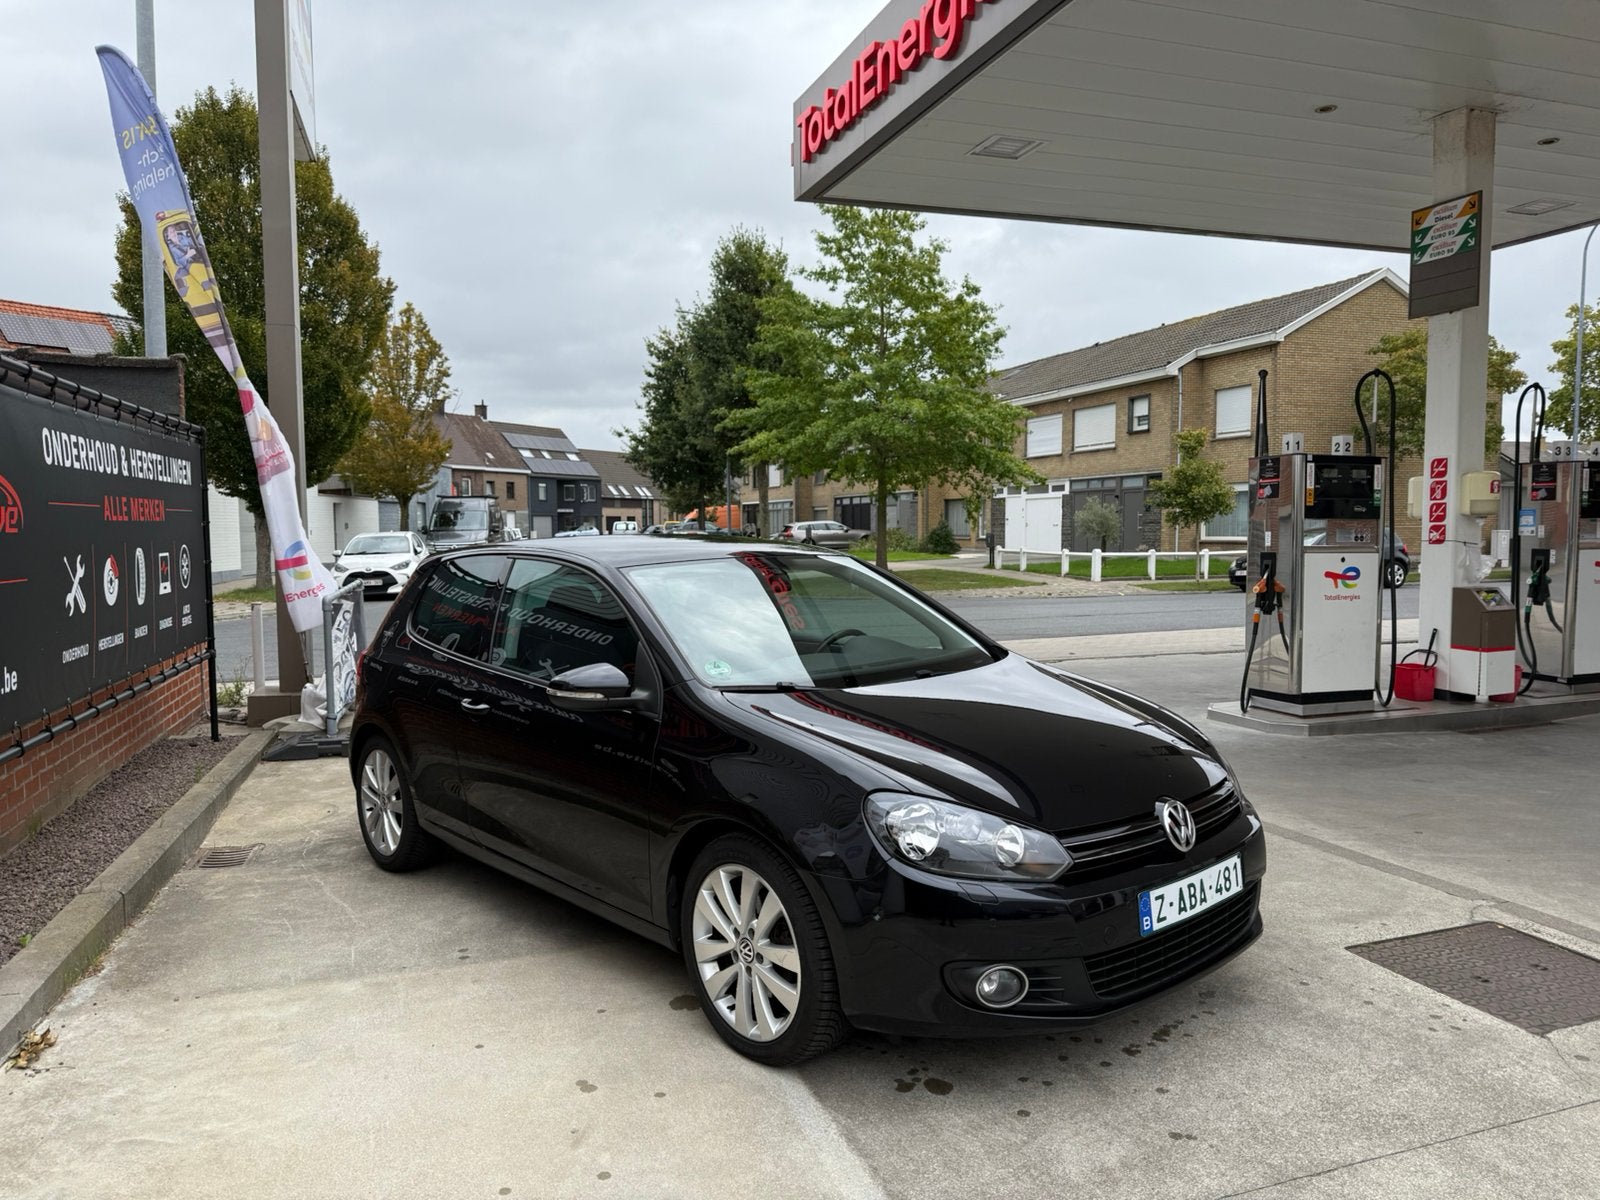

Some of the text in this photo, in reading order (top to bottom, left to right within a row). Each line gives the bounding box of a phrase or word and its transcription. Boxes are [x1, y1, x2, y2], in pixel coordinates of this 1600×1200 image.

[1434, 213, 1454, 223] Diesel
[1430, 229, 1456, 241] EURO 95
[1429, 249, 1445, 259] EURO
[1285, 440, 1290, 451] 1
[1295, 440, 1300, 451] 1
[1334, 442, 1341, 452] 2
[1345, 441, 1351, 452] 2
[1554, 446, 1562, 456] 3
[1565, 446, 1571, 456] 3
[42, 427, 192, 486] ONDERHOUD & HERSTELLINGEN
[1592, 447, 1599, 456] 4
[104, 495, 165, 521] ALLE MERKEN
[1324, 594, 1361, 602] TotalEnergies
[62, 643, 89, 664] ONDERHOUD
[1, 666, 17, 694] .be
[1143, 916, 1151, 930] B
